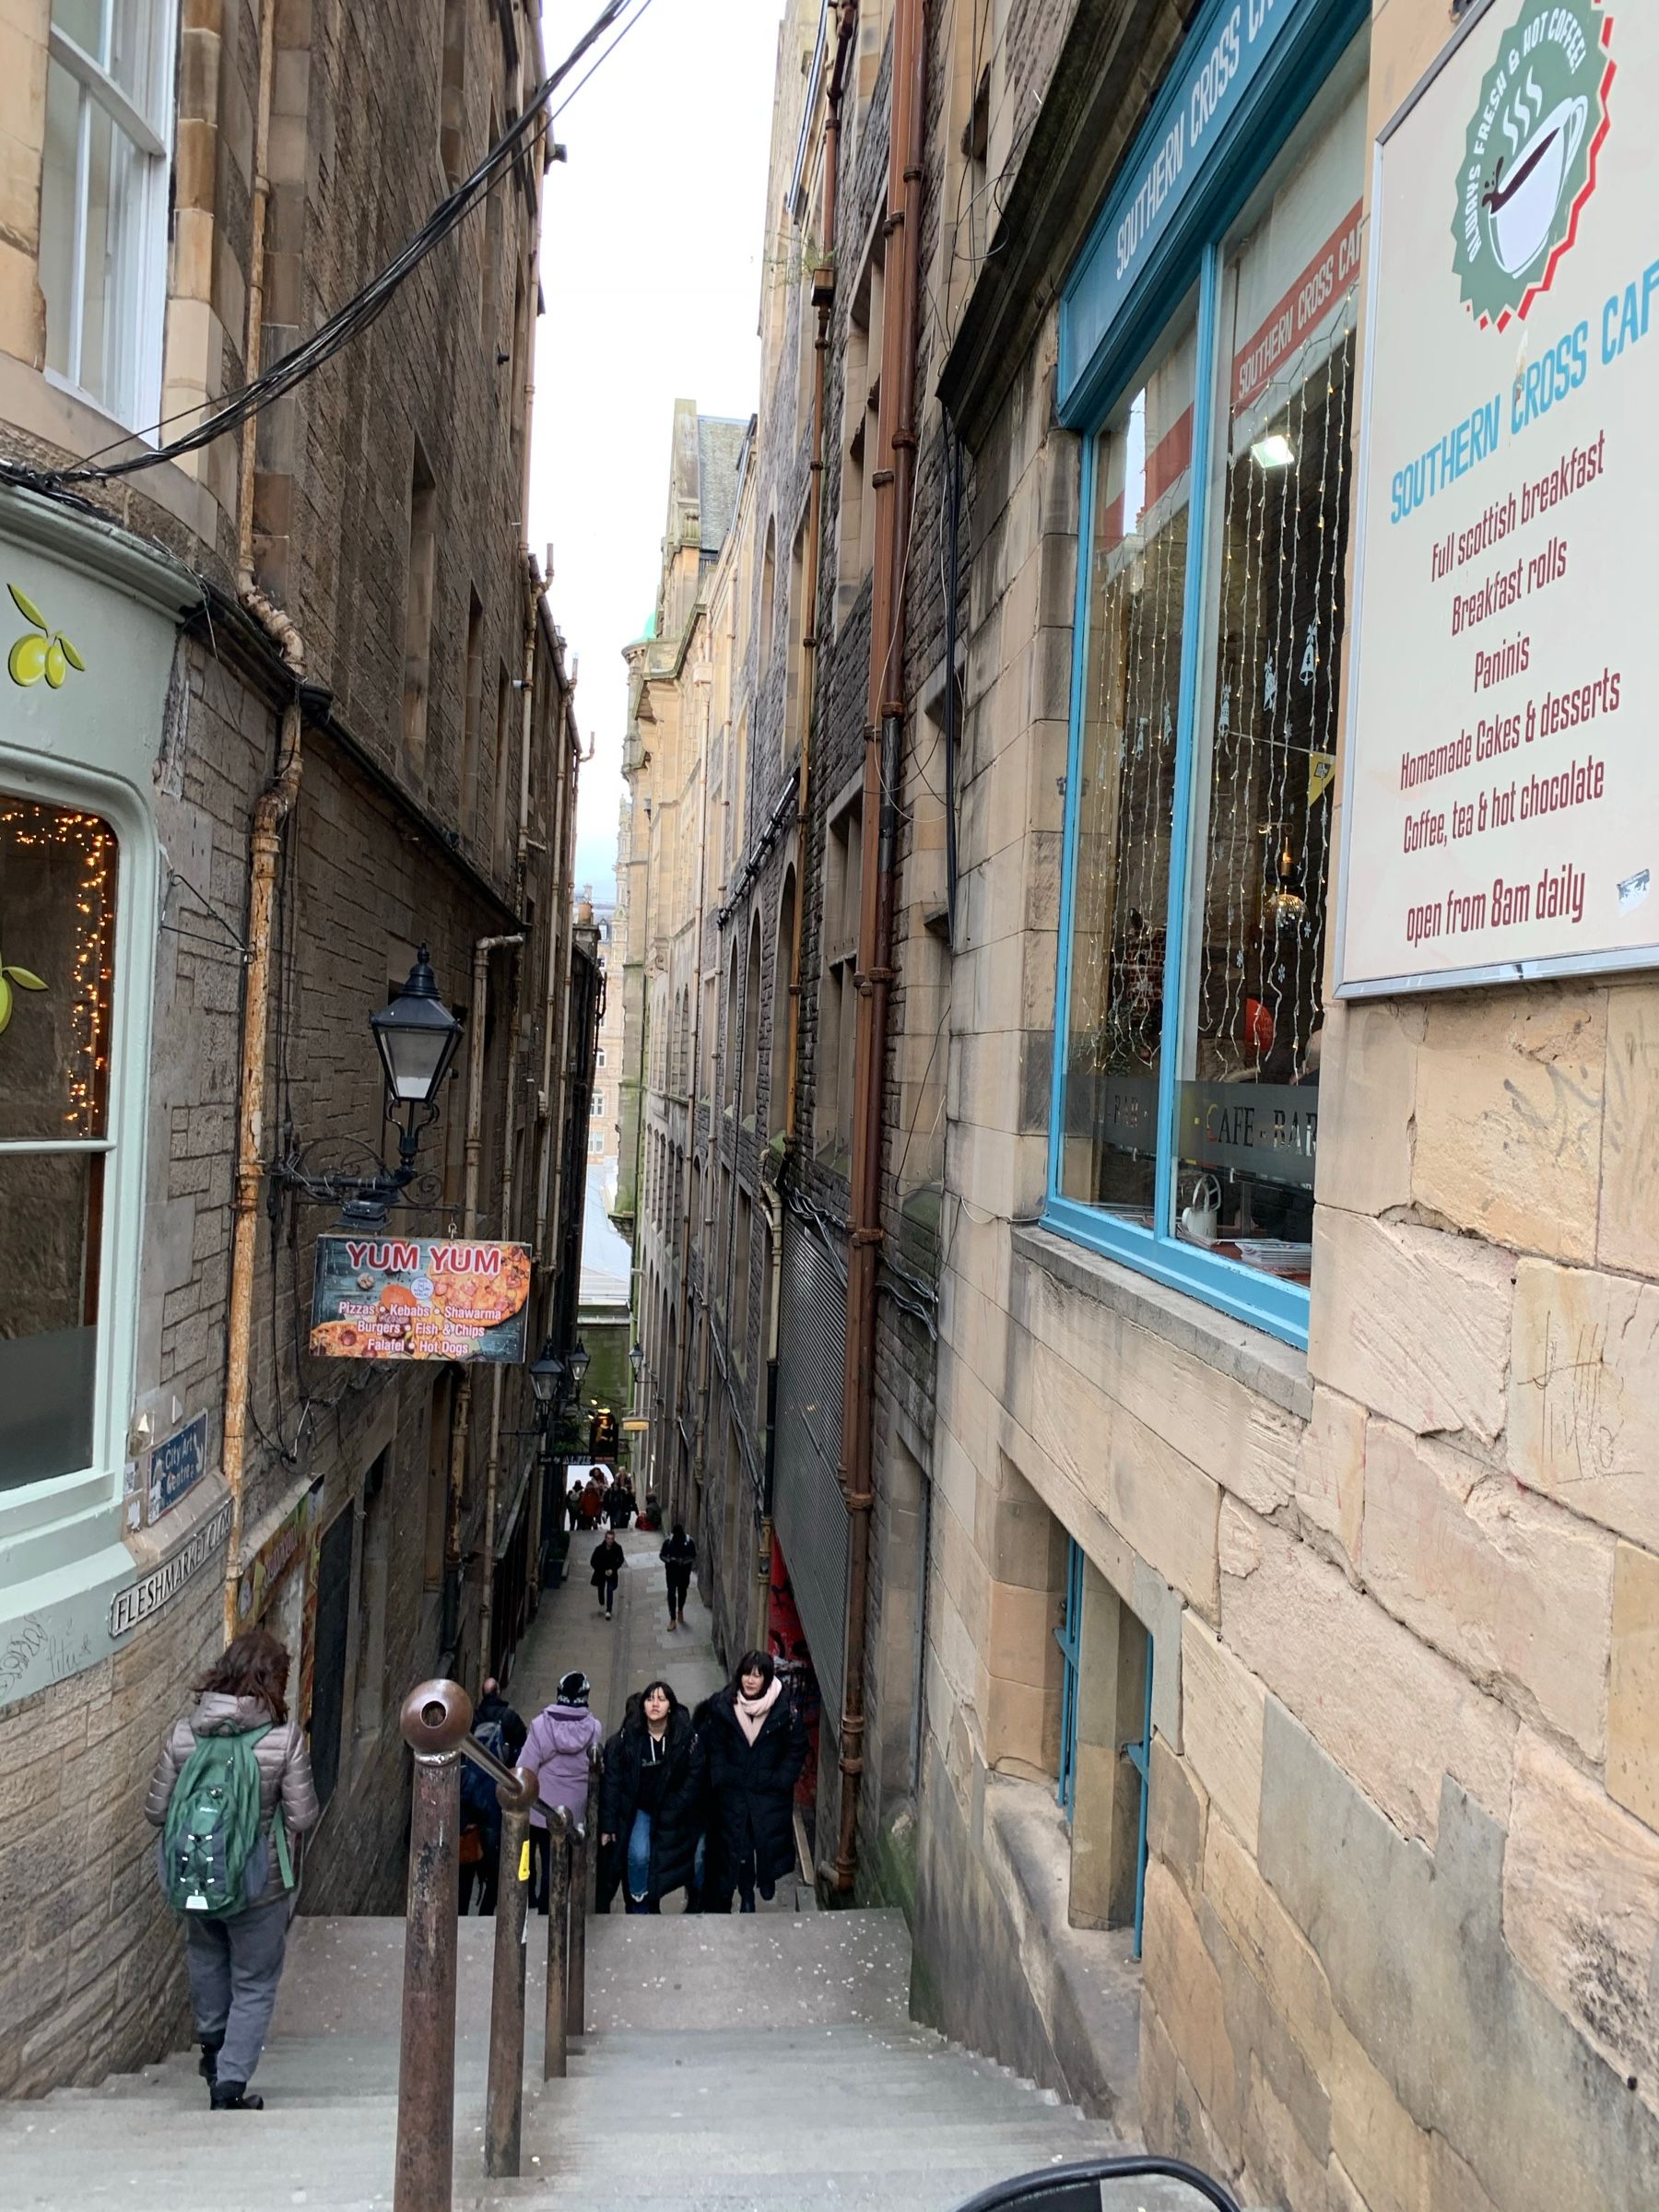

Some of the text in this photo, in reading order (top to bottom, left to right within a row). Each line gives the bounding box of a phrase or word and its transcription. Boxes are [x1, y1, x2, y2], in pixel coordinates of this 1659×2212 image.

[1116, 111, 1185, 280] SOUTHERN
[1190, 5, 1241, 147] CROSS
[1465, 164, 1482, 263] ALWAYS
[1474, 70, 1507, 155] FRESH
[1524, 10, 1549, 57] HOT
[1548, 7, 1586, 75] COFFEE!
[1239, 305, 1293, 399] SOUTHERN
[1298, 254, 1334, 330] CROSS
[1391, 394, 1500, 524] SOUTHERN
[1511, 321, 1588, 434] CROSS
[1431, 429, 1605, 582] Full scottish breakfast
[1452, 537, 1567, 636] Breakfast rolls
[1475, 631, 1529, 692] Paninis
[1400, 667, 1620, 791] Homemade Cakes & desserts
[1404, 755, 1605, 853] Coffee, tea & hot chocolate
[1406, 863, 1585, 947] open from 8am daily
[1206, 1103, 1255, 1147] CAFE
[347, 1241, 501, 1275] YUM YUM
[339, 1301, 501, 1320] Pizzas Kebabs Shawarma
[358, 1321, 401, 1336] Burgers
[416, 1323, 438, 1335] Fish
[454, 1324, 485, 1337] Chips
[368, 1339, 468, 1355] Falafel Hot Dogs
[166, 1434, 194, 1469] City Art
[115, 1534, 206, 1630] FLESHMARKET
